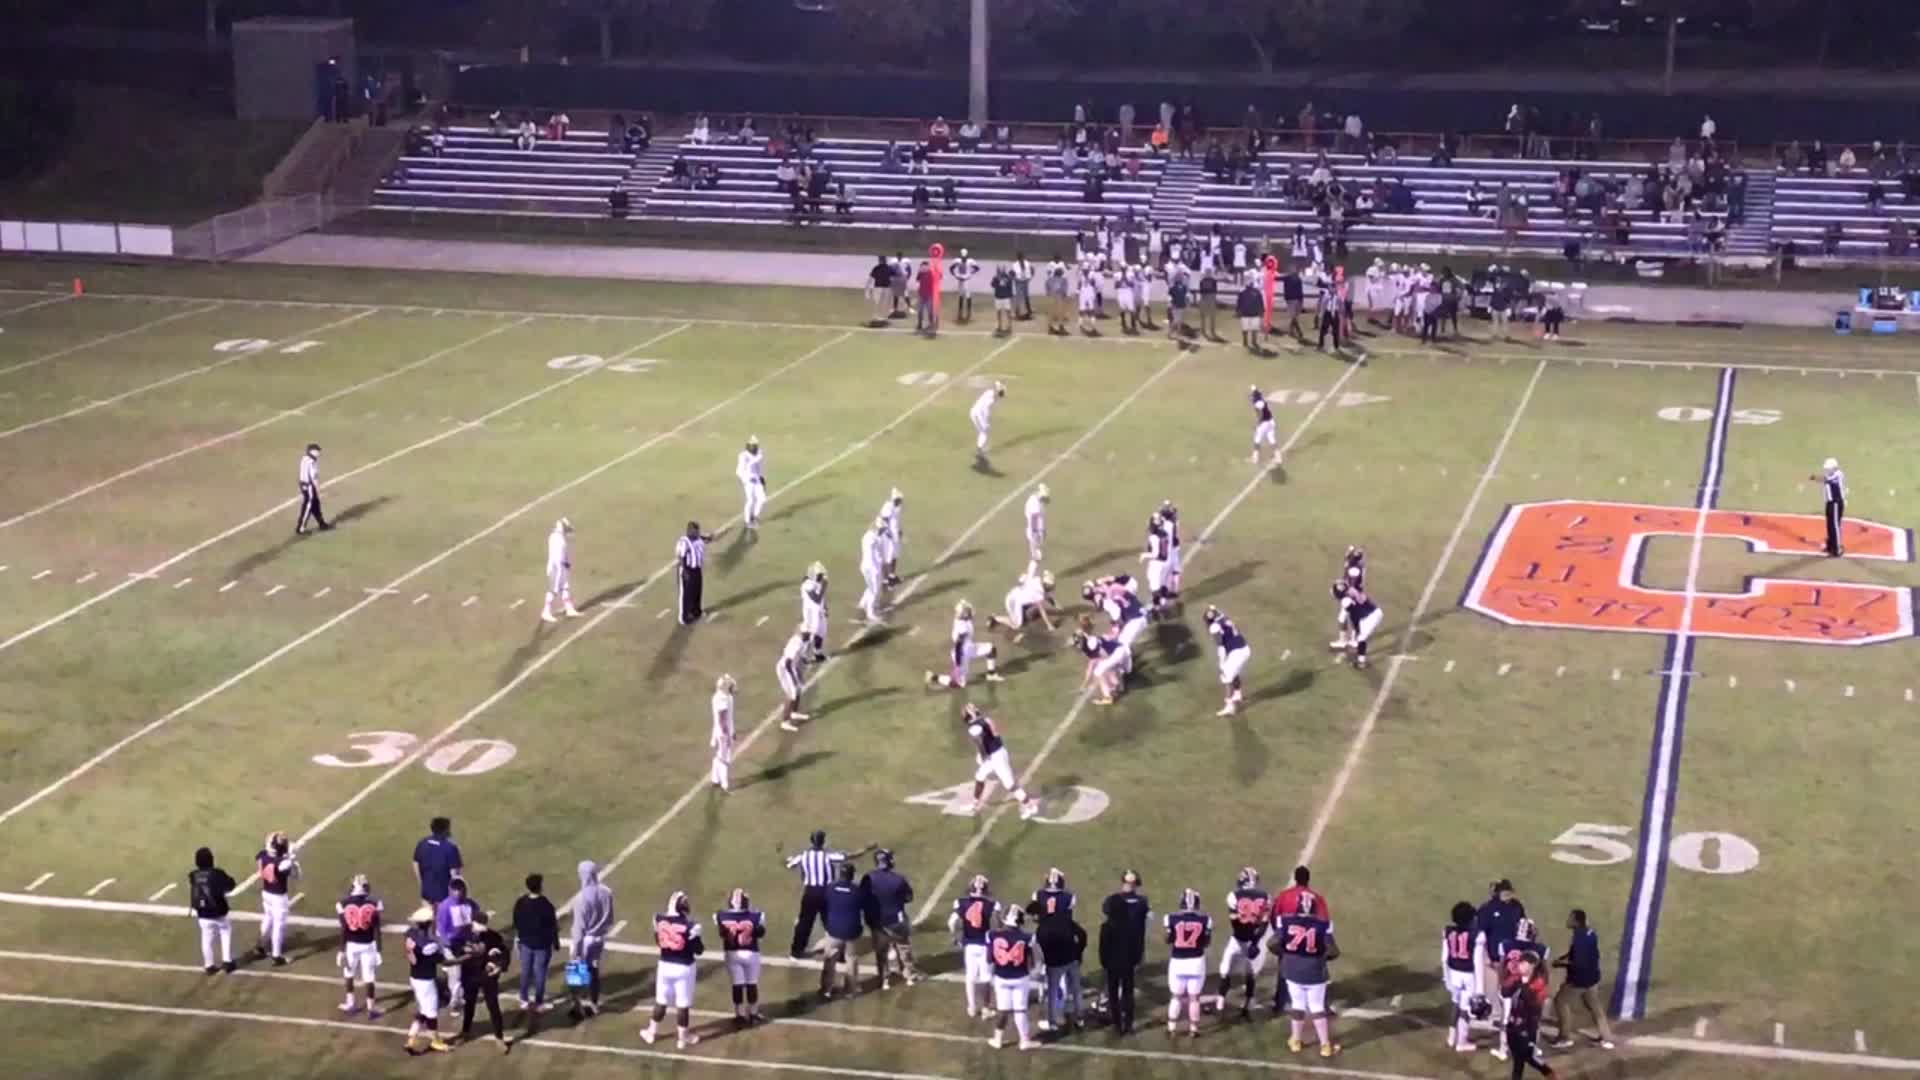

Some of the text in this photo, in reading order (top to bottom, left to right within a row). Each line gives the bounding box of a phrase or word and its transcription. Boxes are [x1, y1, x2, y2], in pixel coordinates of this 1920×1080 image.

[546, 354, 664, 373] 20
[1657, 406, 1783, 425] 50
[1463, 498, 1916, 643] C
[312, 730, 517, 775] 30
[1549, 822, 1760, 874] 50
[965, 900, 984, 927] 4
[1174, 920, 1202, 948] 17
[1285, 924, 1317, 953] 71
[1447, 930, 1468, 959] 11
[992, 940, 1025, 967] 64
